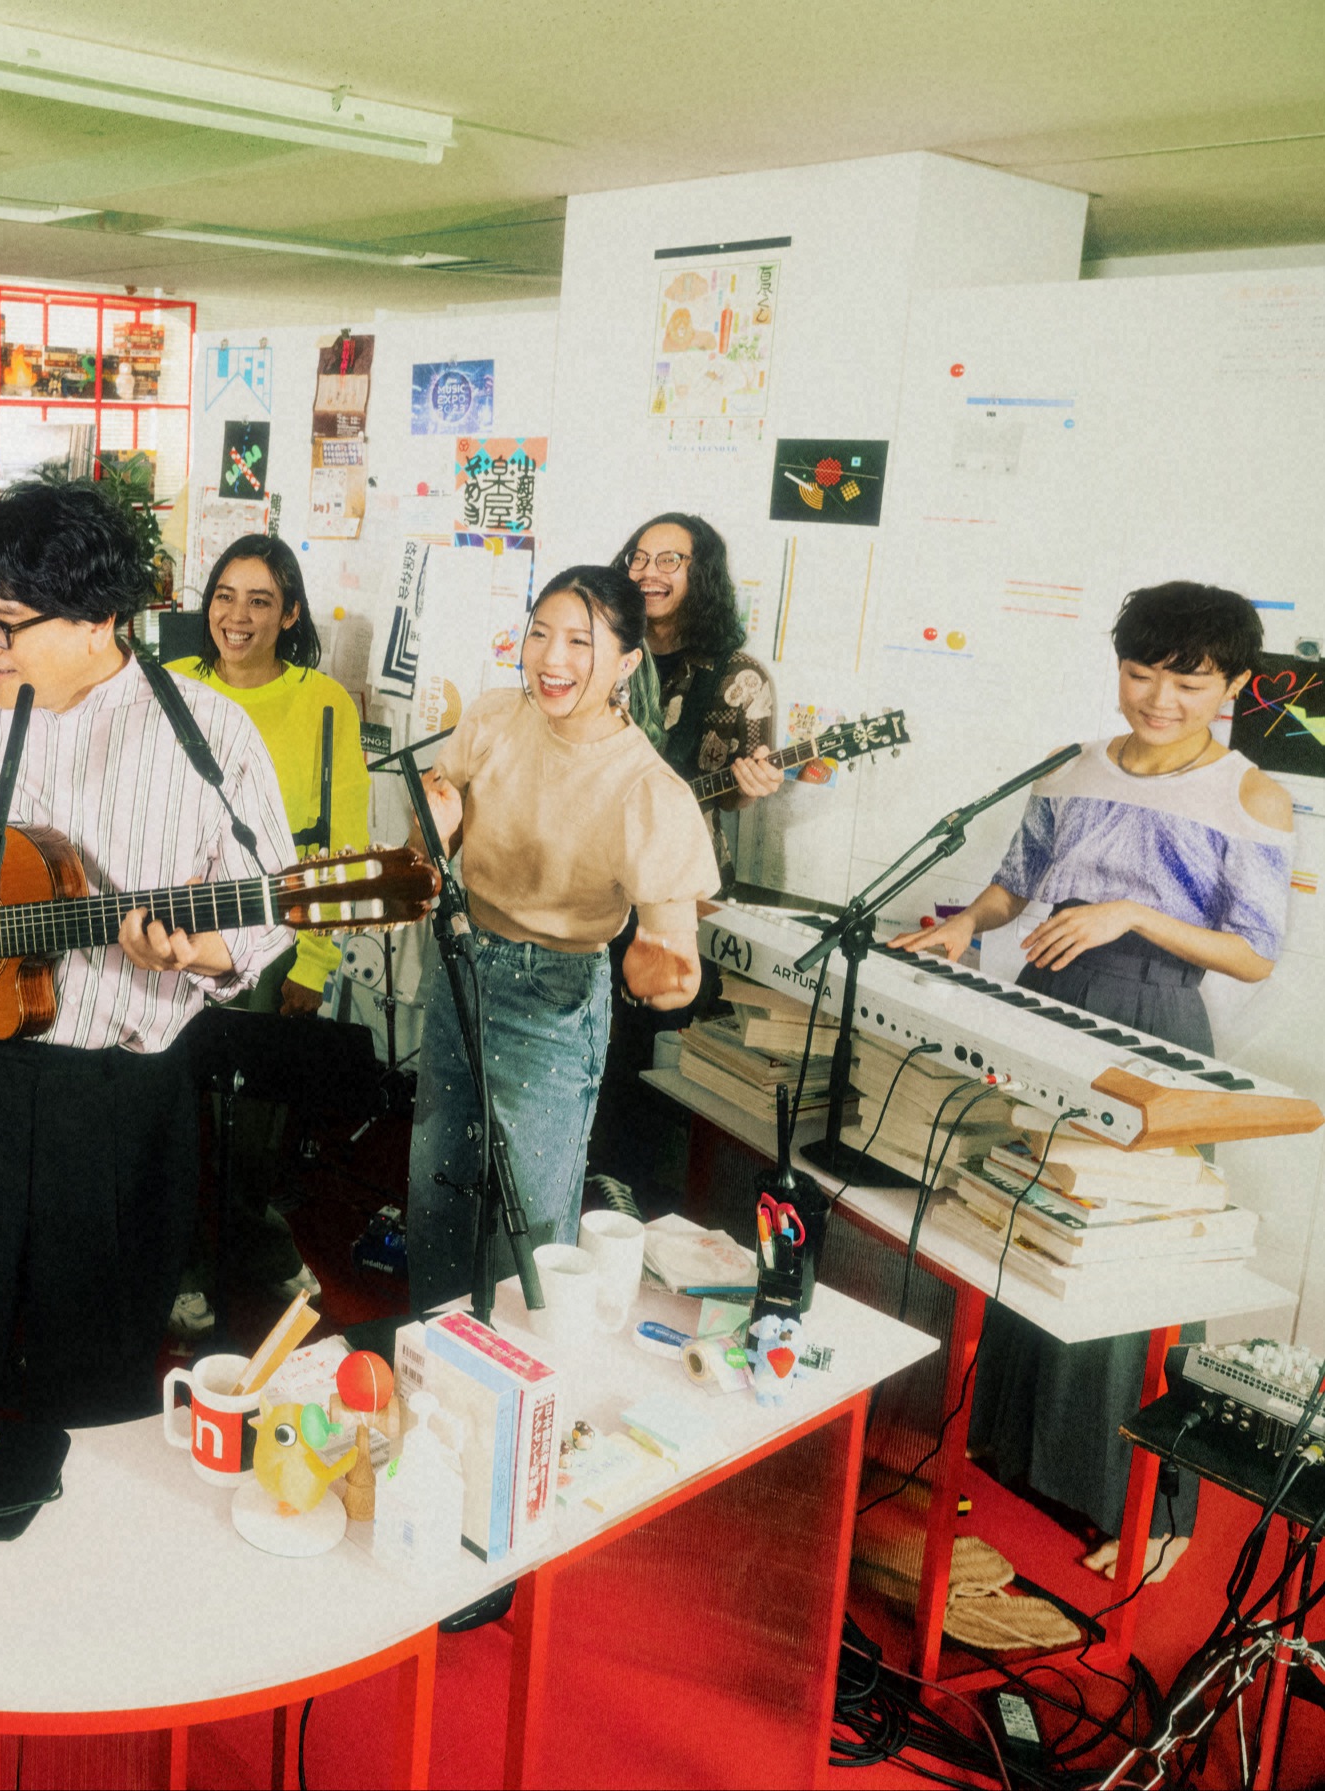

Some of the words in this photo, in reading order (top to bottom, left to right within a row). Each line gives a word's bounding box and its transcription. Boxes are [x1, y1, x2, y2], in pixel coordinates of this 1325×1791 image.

[437, 384, 466, 395] MUSIC
[437, 394, 466, 404] EXPO
[425, 676, 442, 733] UTA-CON
[360, 735, 389, 749] ONGS
[772, 964, 833, 1000] ARTURA
